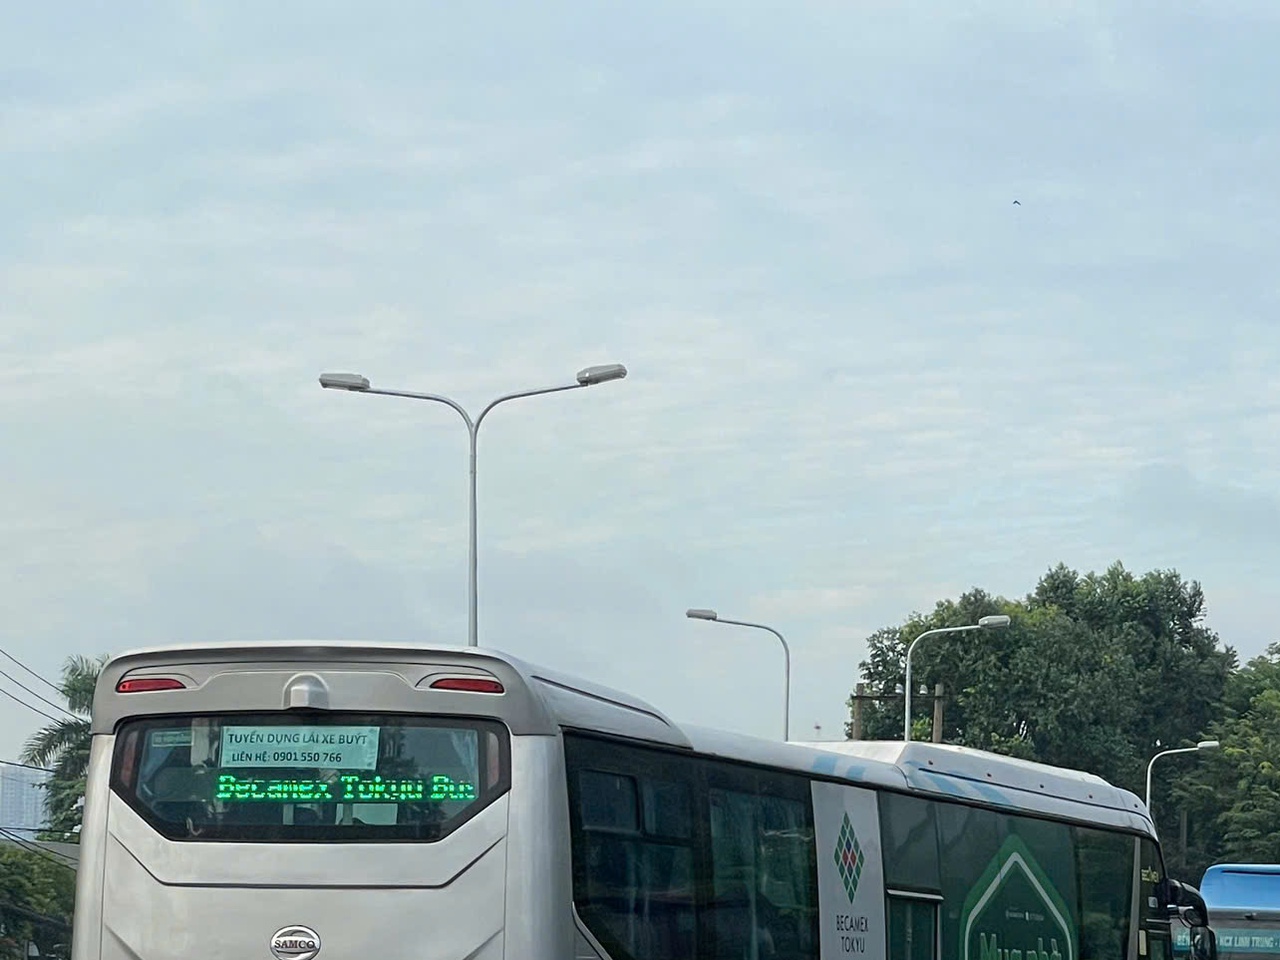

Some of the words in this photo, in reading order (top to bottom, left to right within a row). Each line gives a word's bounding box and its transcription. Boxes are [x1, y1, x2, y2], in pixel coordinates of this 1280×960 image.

[267, 733, 300, 746] DỤNG
[302, 732, 319, 744] LÁI
[321, 735, 336, 744] XE
[338, 732, 368, 745] BUÝT
[231, 750, 254, 762] LIÊN
[273, 752, 300, 762] 0901
[300, 752, 321, 763] 550
[322, 753, 342, 763] 766
[836, 914, 869, 933] BECAMEX
[274, 939, 316, 950] SAMCO
[841, 935, 865, 954] TOKYU
